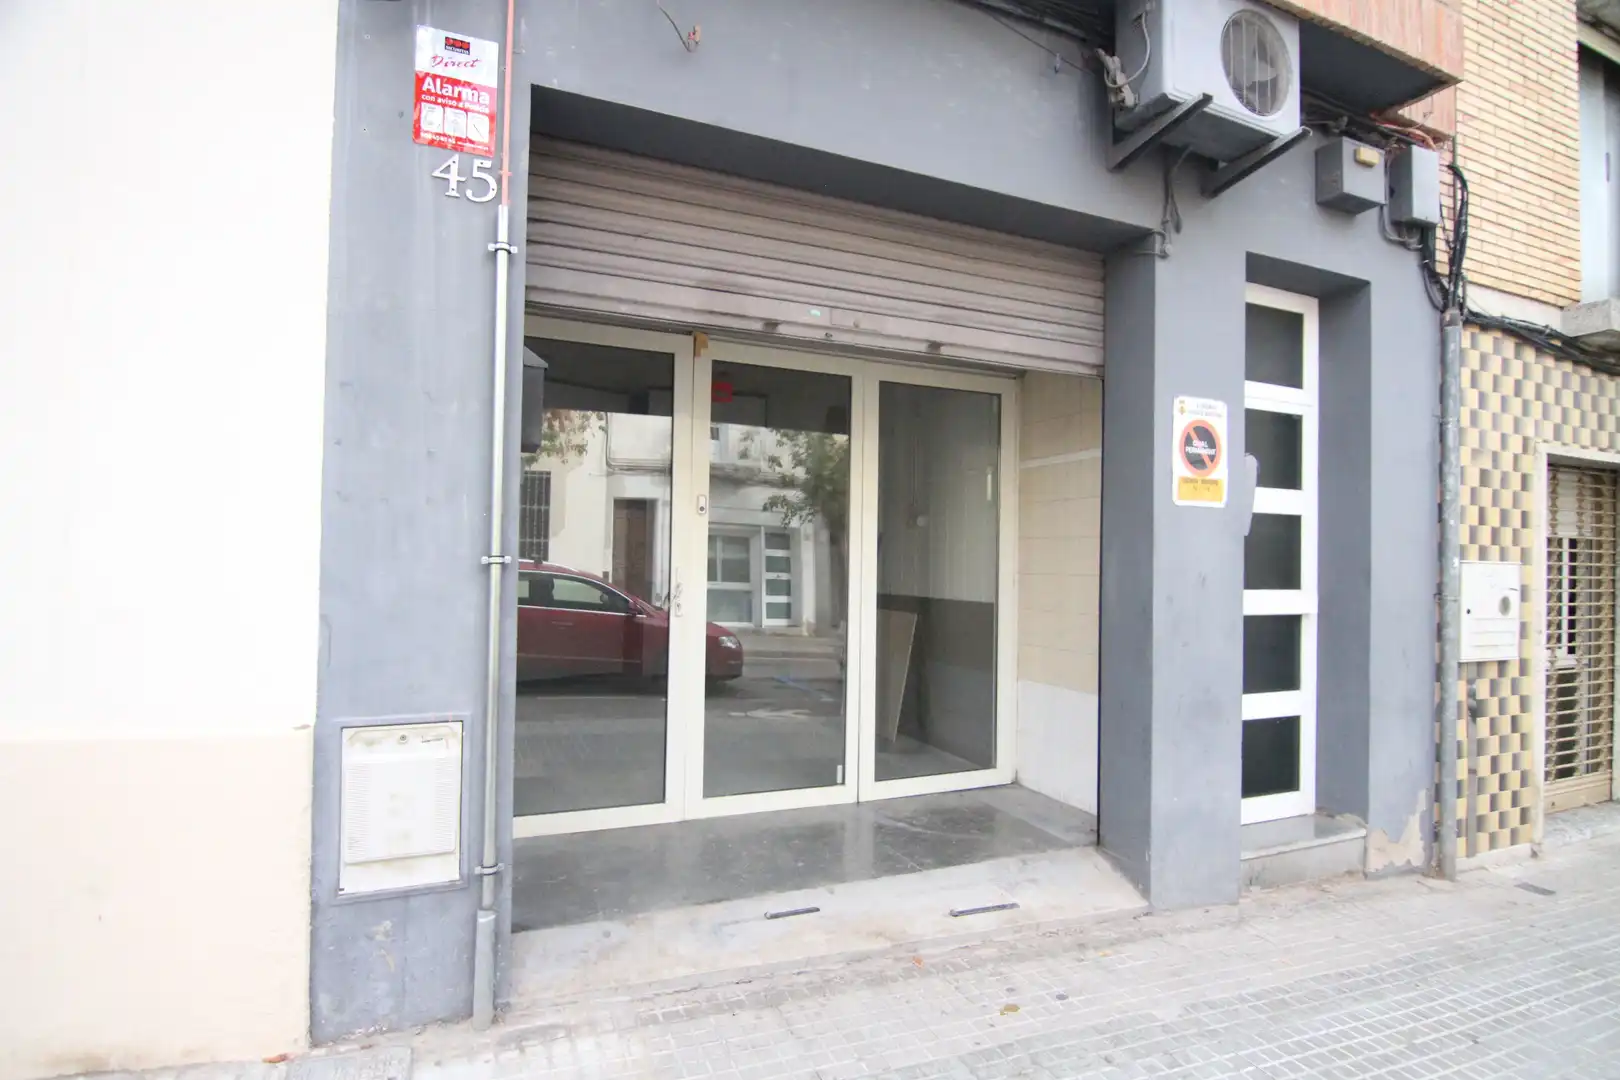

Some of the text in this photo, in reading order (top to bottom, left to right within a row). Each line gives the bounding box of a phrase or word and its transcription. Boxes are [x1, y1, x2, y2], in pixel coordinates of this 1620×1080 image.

[431, 55, 482, 68] Direct
[421, 94, 436, 102] con
[437, 96, 457, 106] aviso
[422, 76, 490, 105] Alarma
[431, 153, 498, 203] 45
